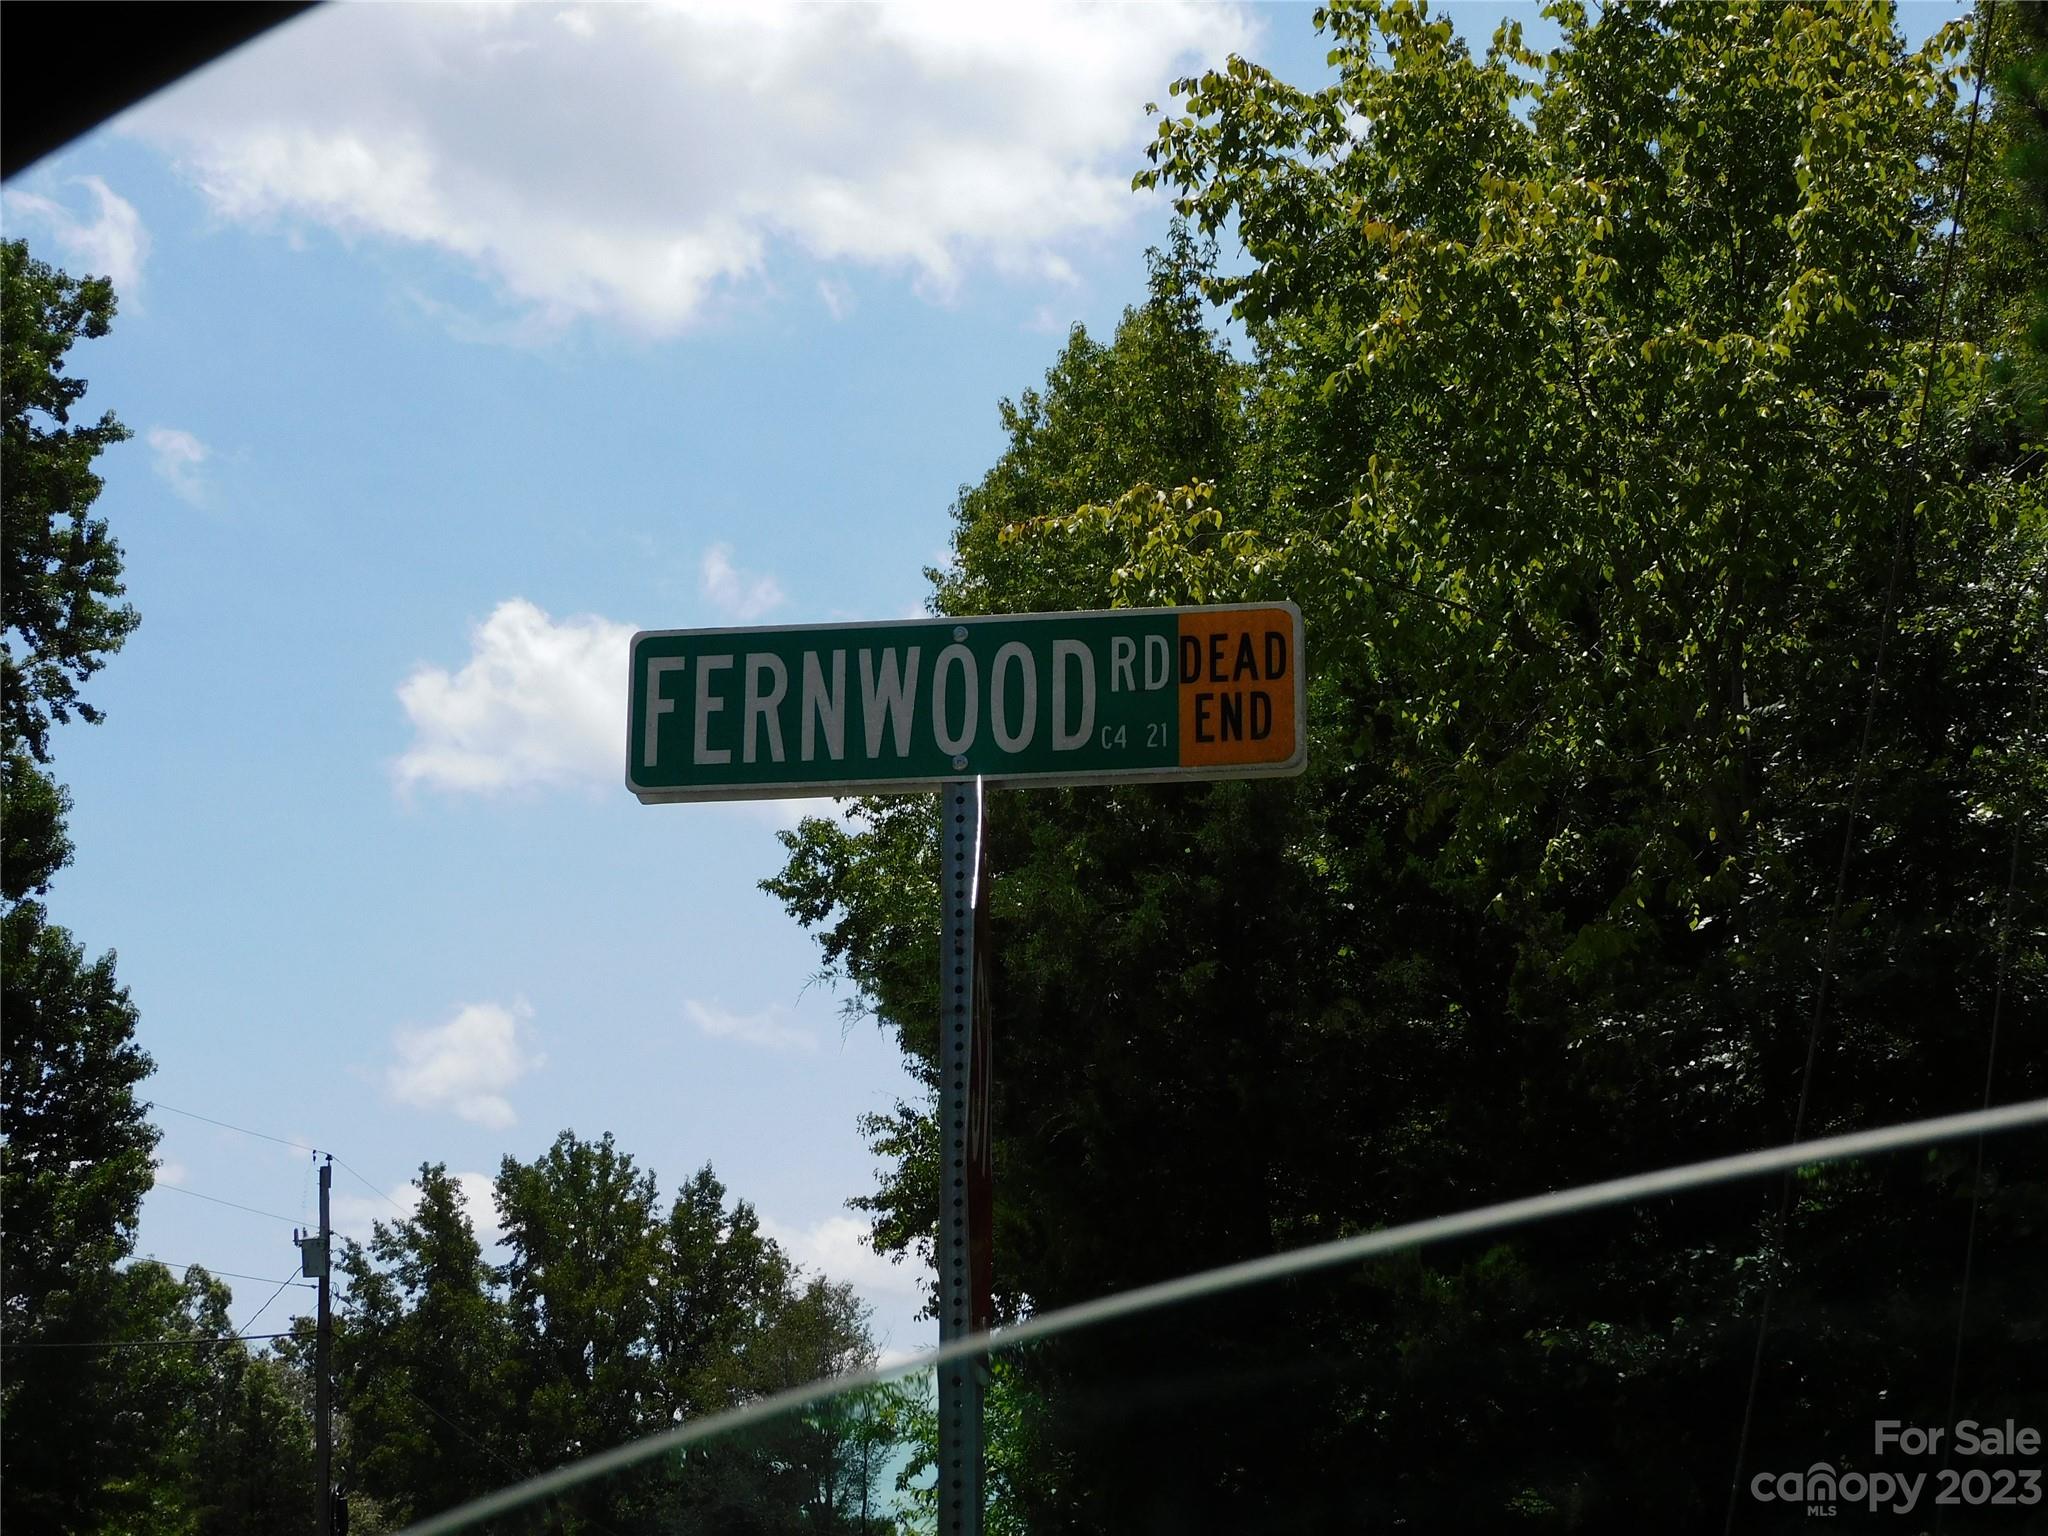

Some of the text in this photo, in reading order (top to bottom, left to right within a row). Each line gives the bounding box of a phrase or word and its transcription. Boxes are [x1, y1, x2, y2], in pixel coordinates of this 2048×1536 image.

[1180, 631, 1287, 684] DEAD
[643, 634, 1170, 768] FERNWOOD RD
[1194, 692, 1273, 744] END
[1147, 722, 1167, 749] 21
